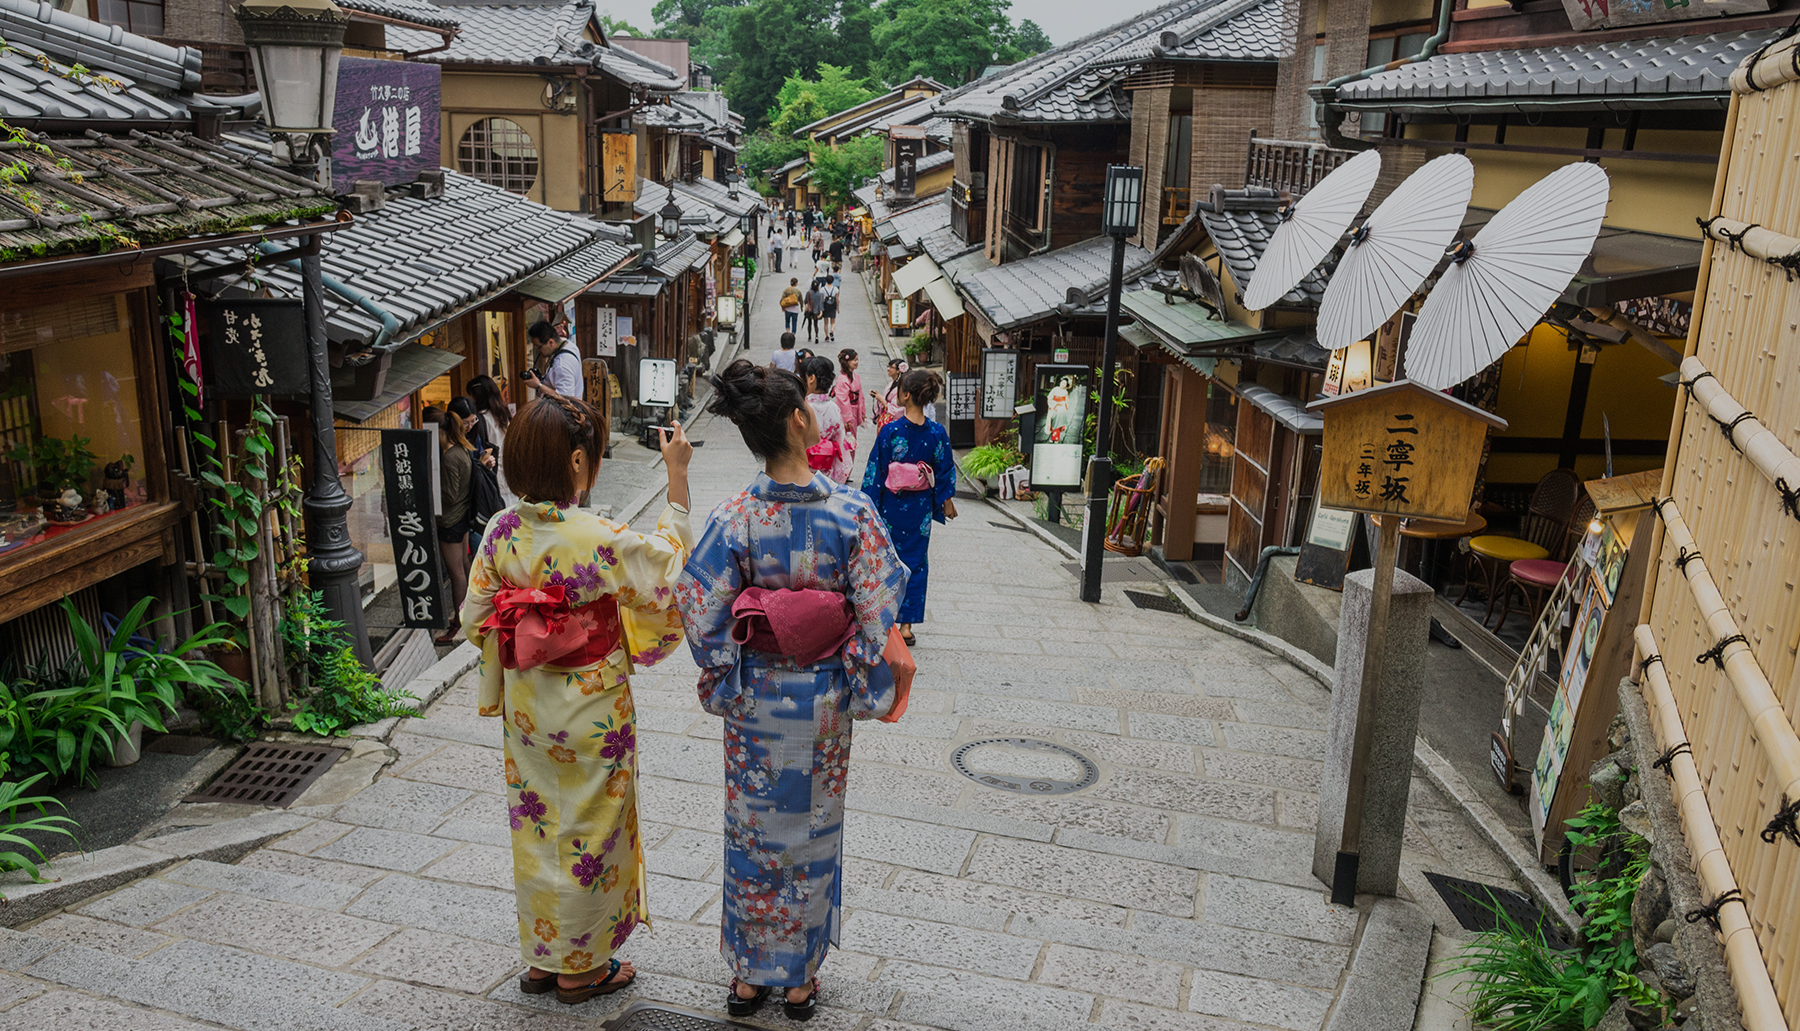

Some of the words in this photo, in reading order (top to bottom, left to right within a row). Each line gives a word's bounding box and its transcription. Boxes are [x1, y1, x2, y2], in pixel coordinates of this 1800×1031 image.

[370, 85, 410, 101] 竹久夢二の店
[382, 105, 421, 158] 港屋
[985, 385, 996, 412] ふたば
[394, 442, 417, 508] 丹波黒
[1354, 442, 1376, 500] (二年坂)
[1379, 413, 1419, 505] 二寧坂
[398, 511, 433, 621] きんつば
